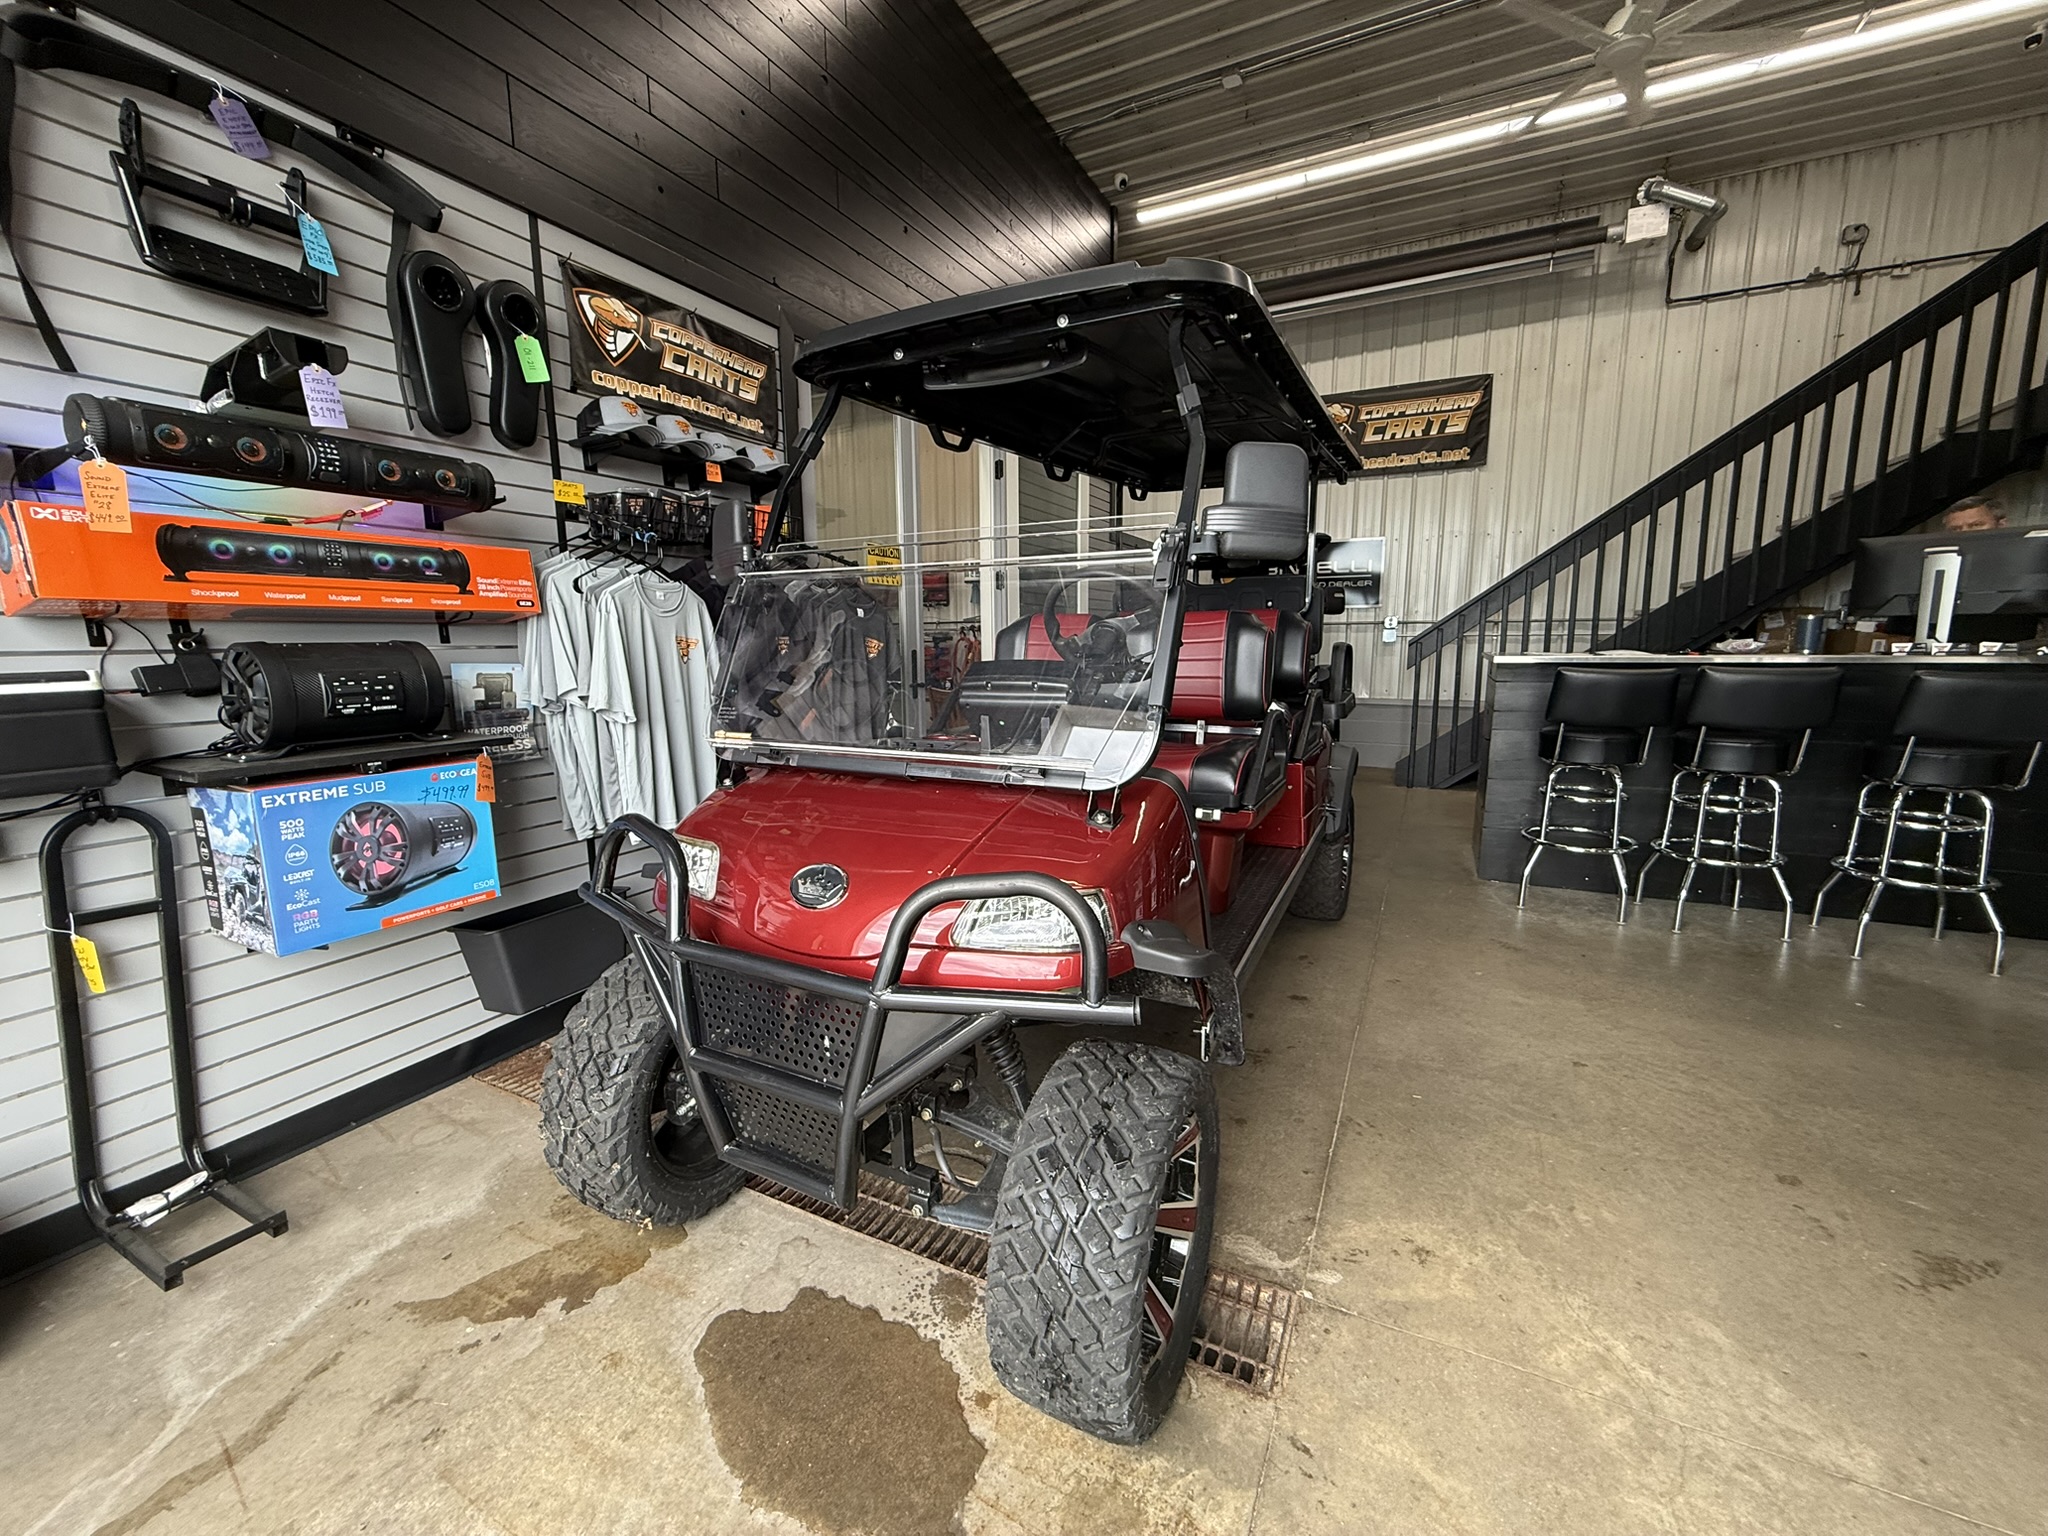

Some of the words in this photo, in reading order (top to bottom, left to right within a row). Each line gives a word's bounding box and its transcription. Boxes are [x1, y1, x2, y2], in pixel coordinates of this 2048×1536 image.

[652, 321, 766, 378] COPPERHEAD
[663, 345, 759, 401] CARTS
[591, 370, 766, 434] copperheadcarts.net
[1360, 394, 1480, 420] COPPERHEAD
[1364, 410, 1471, 442] CARTS
[1360, 447, 1471, 469] headcarts.net
[84, 471, 112, 482] SOUND
[86, 482, 120, 492] EXTREME
[90, 491, 115, 499] ELITE
[61, 509, 87, 518] SOU
[869, 547, 899, 558] CAUTION
[191, 588, 239, 598] Shockproof
[264, 591, 306, 600] Waterproof
[328, 594, 361, 602] Mudproof
[261, 785, 349, 808] EXTREME
[353, 780, 386, 796] SUB
[280, 818, 304, 829] 500
[280, 827, 305, 835] WATTS
[281, 832, 305, 841] PEAK
[286, 898, 321, 911] EcoCast
[293, 909, 318, 921] RGB
[294, 917, 319, 928] PARTY
[294, 923, 320, 934] LIGHTS
